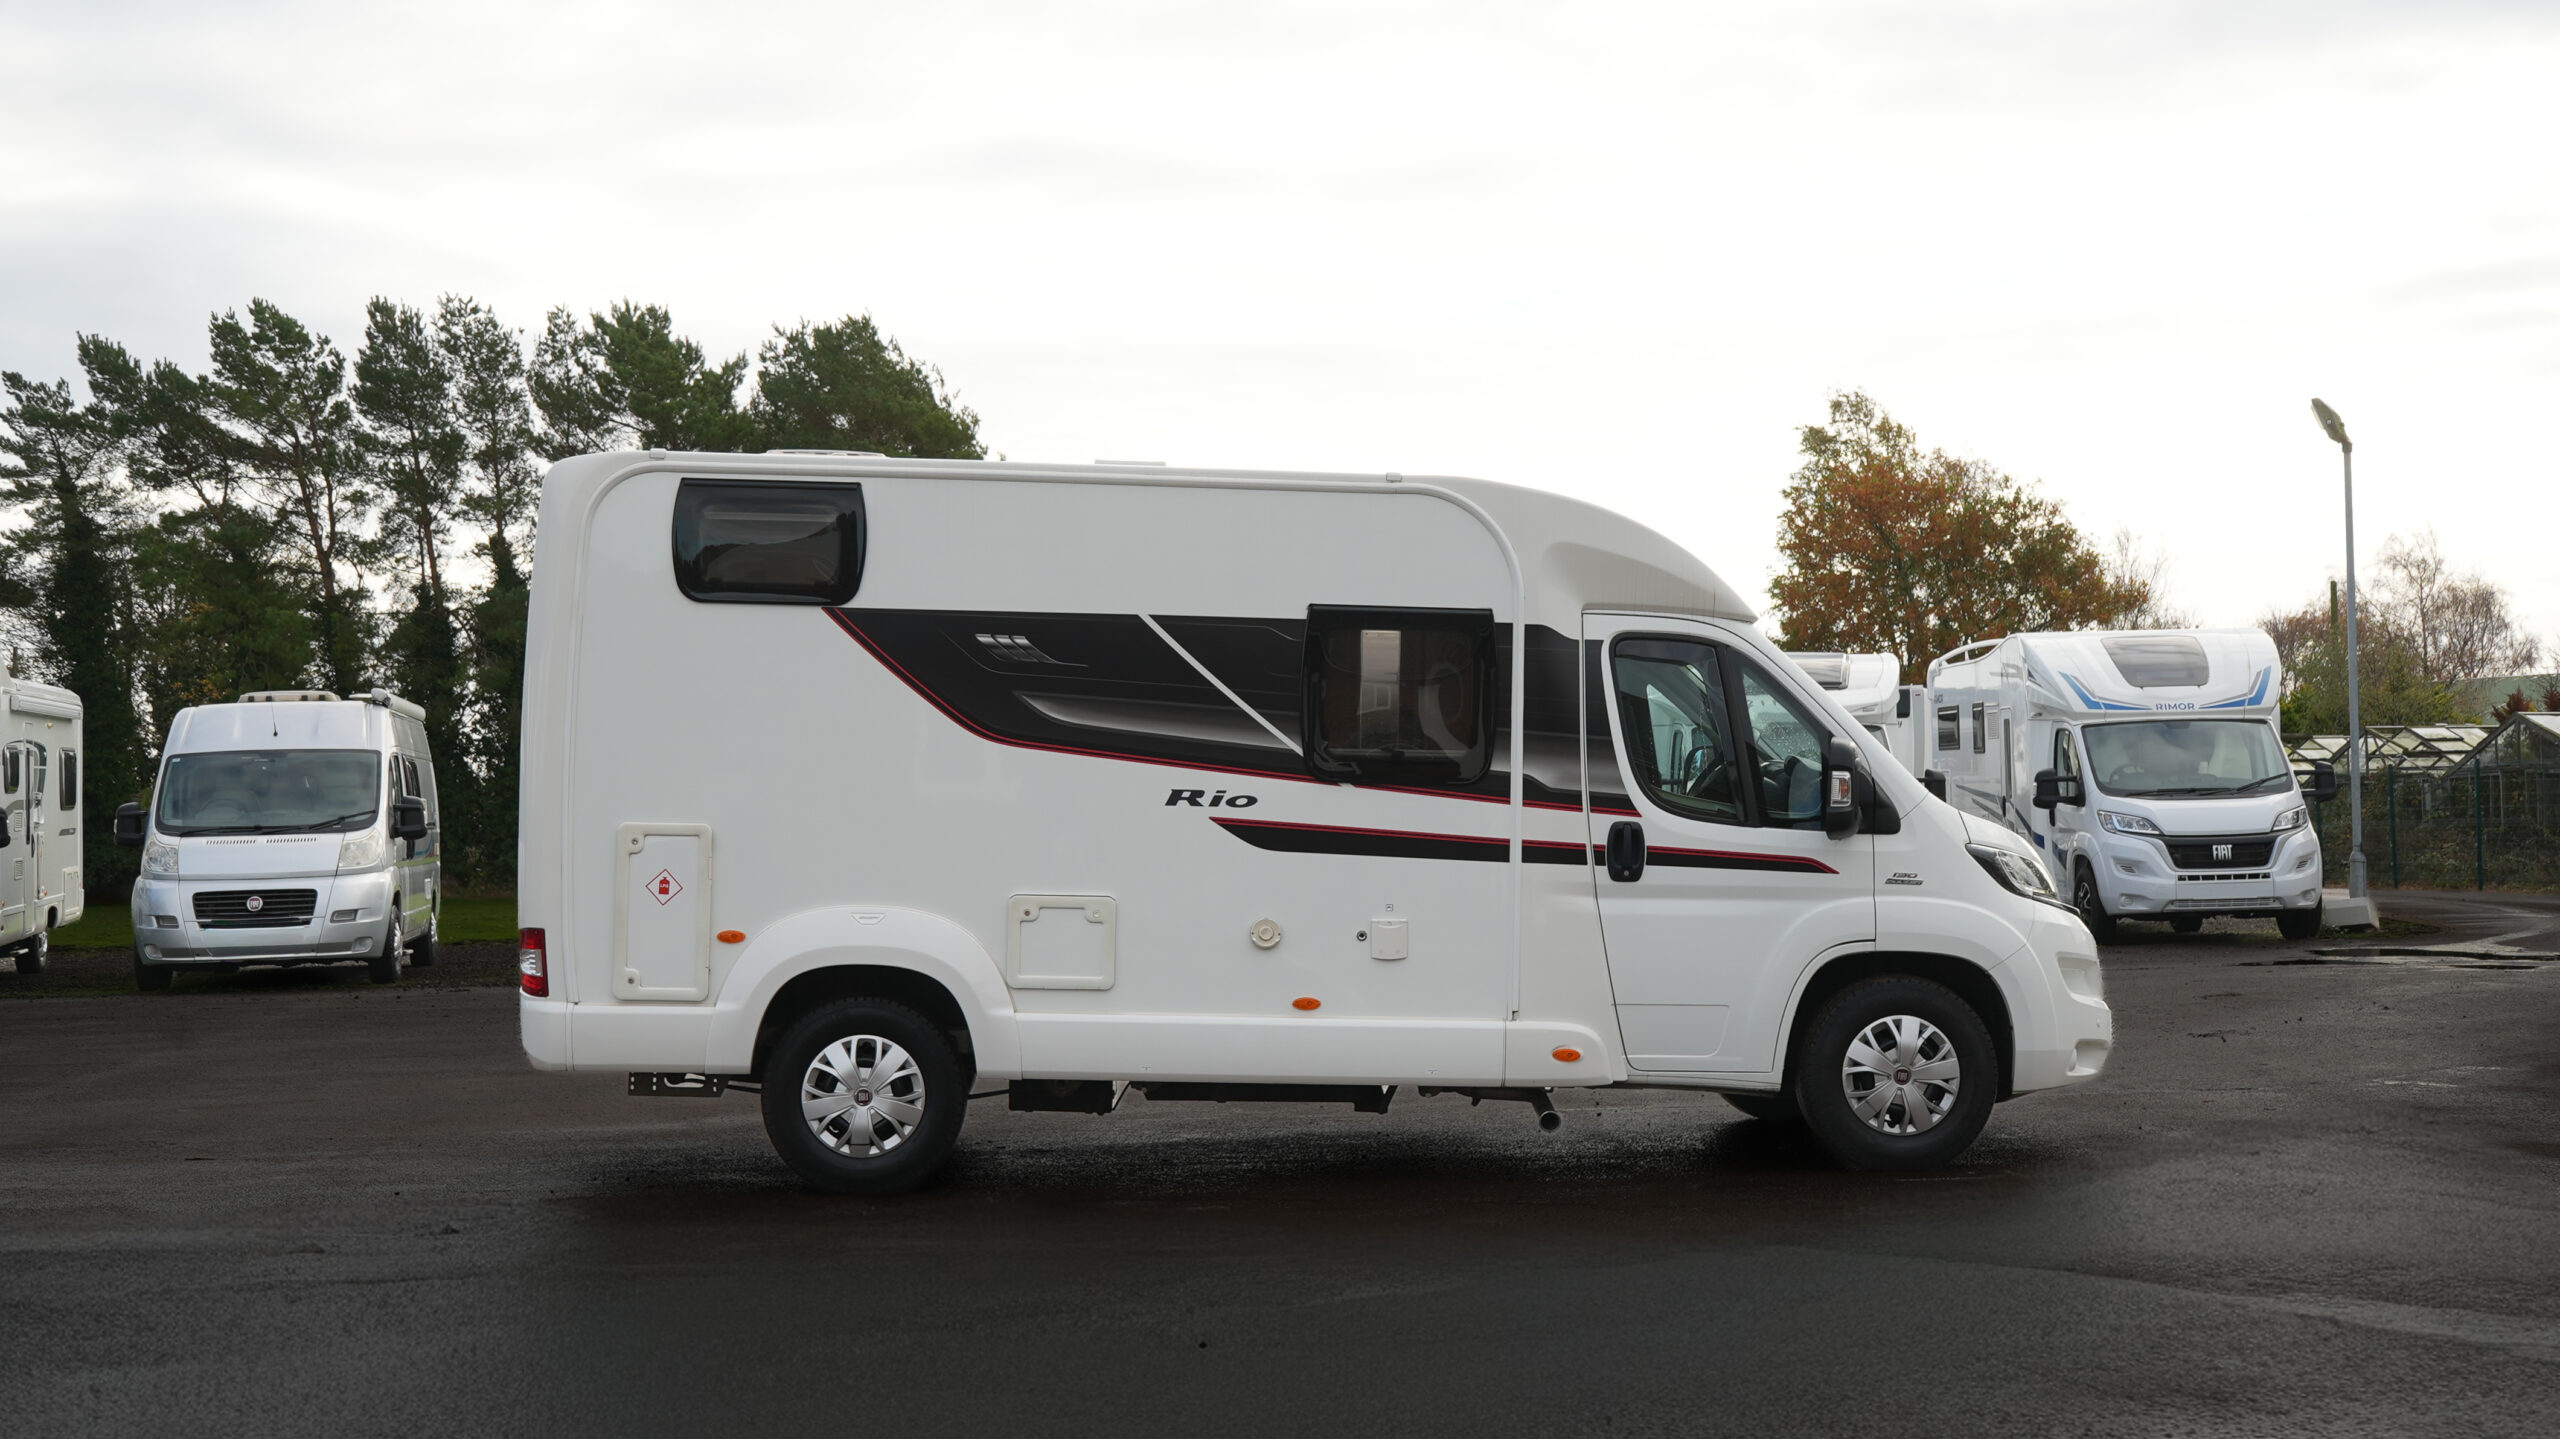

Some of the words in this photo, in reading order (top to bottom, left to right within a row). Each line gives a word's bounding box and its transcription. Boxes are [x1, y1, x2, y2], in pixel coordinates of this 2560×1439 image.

[2155, 702, 2195, 711] RIMOR
[1164, 788, 1258, 809] Rio
[2212, 844, 2233, 860] FIAT
